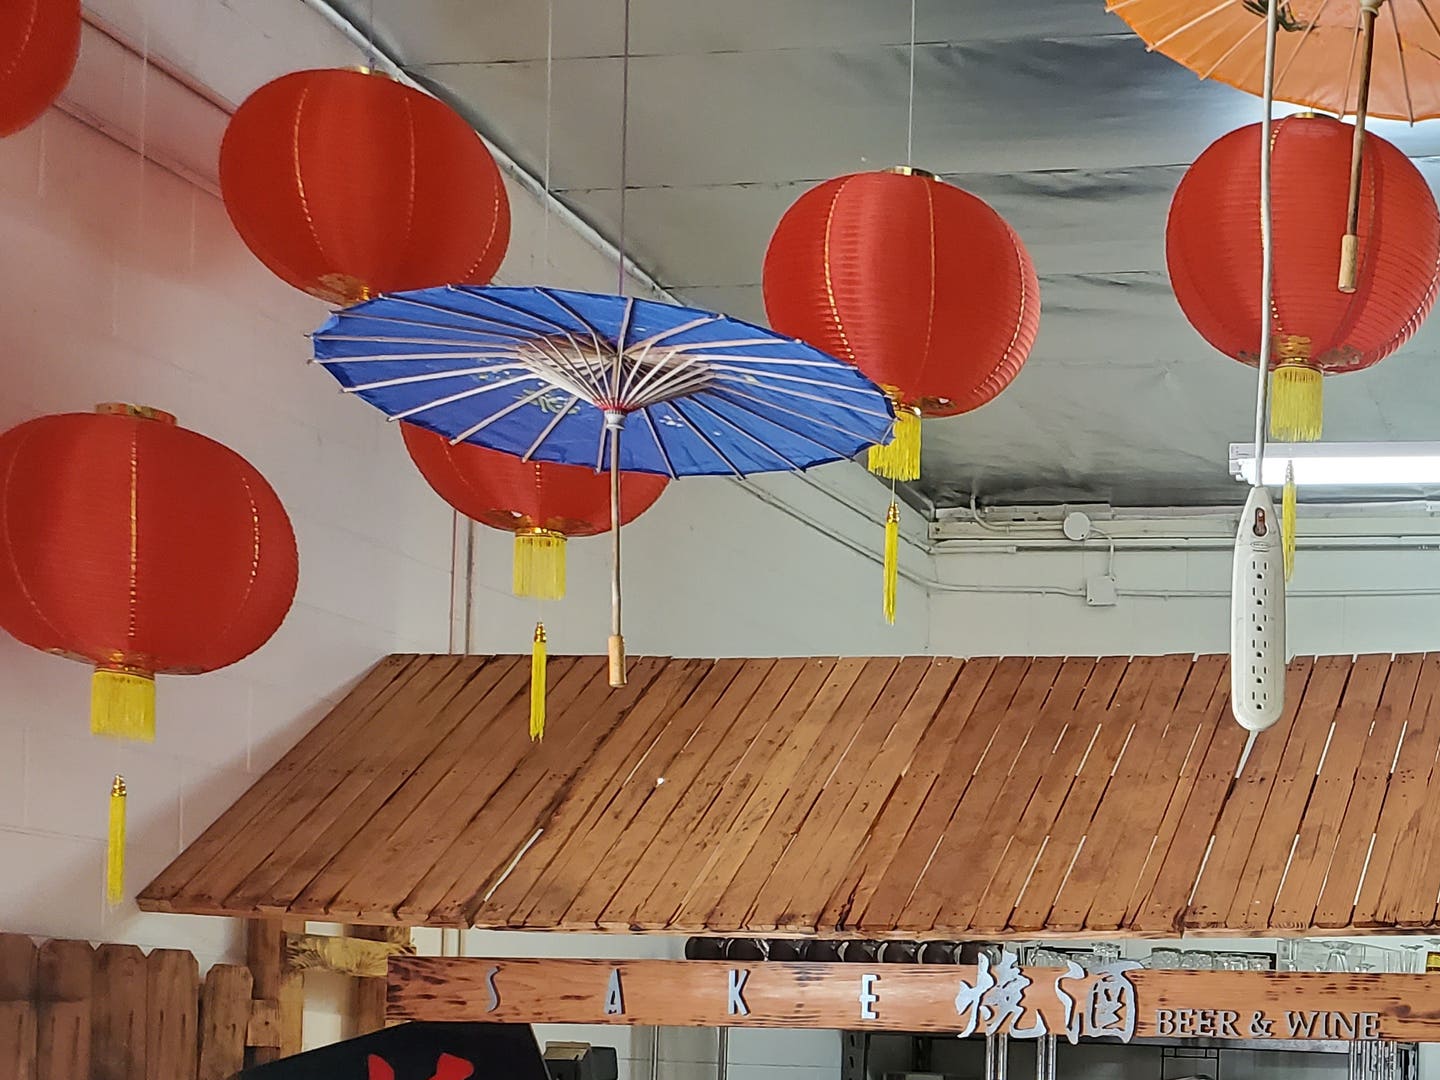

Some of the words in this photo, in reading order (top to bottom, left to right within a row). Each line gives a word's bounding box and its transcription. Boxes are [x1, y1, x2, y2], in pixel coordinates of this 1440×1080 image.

[486, 966, 882, 1020] SAKE
[1156, 1008, 1241, 1038] BEER
[1250, 1010, 1275, 1038] &
[1284, 1010, 1381, 1041] WINE
